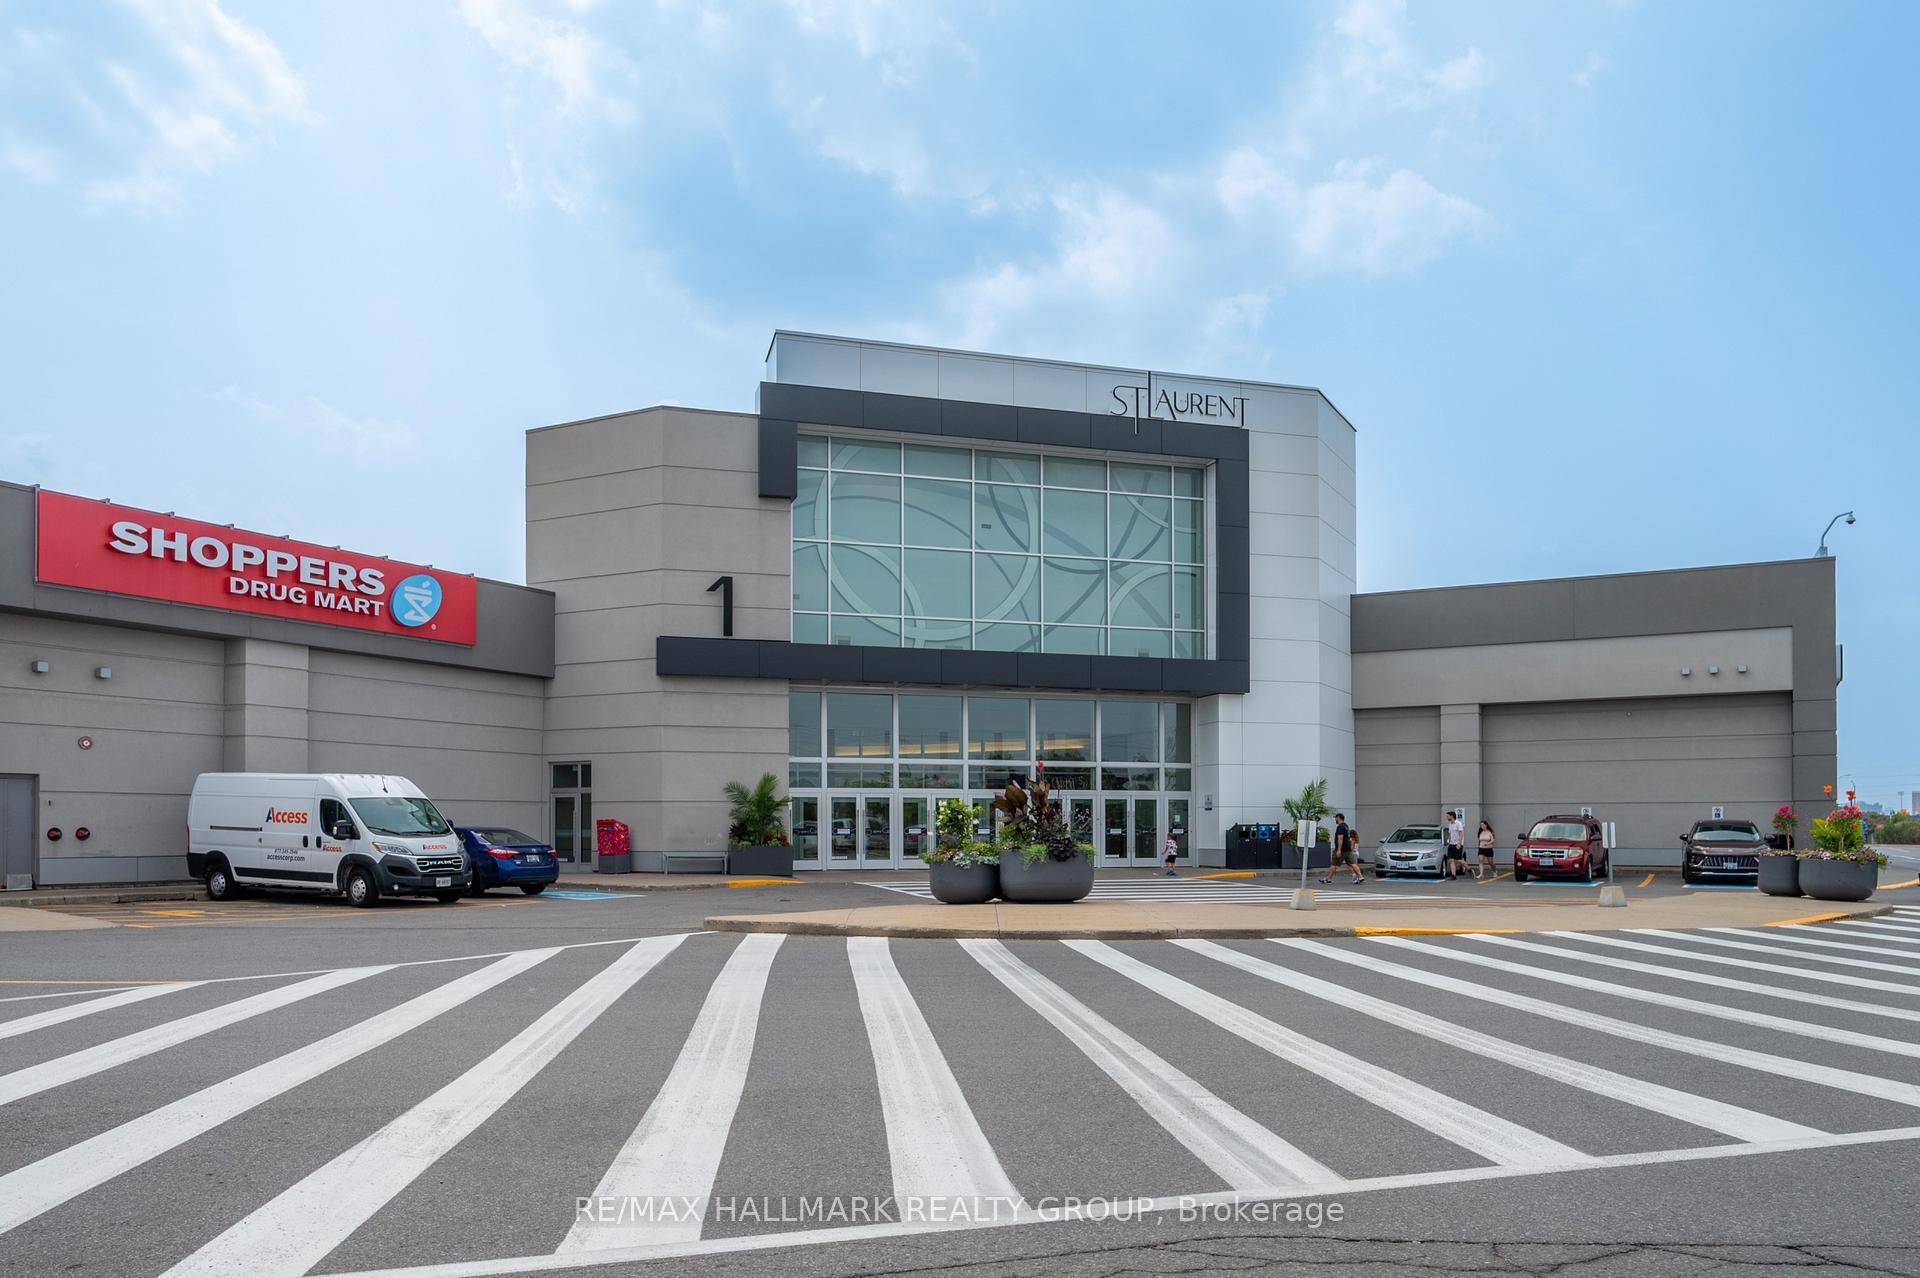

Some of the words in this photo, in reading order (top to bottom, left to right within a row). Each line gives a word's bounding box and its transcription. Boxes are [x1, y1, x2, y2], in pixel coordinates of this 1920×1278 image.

[109, 521, 385, 595] SHOPPERS
[229, 576, 307, 605] DRUG
[314, 591, 384, 616] MART
[706, 576, 733, 636] 1
[265, 807, 308, 824] Access
[267, 854, 305, 862] accesscorp.com
